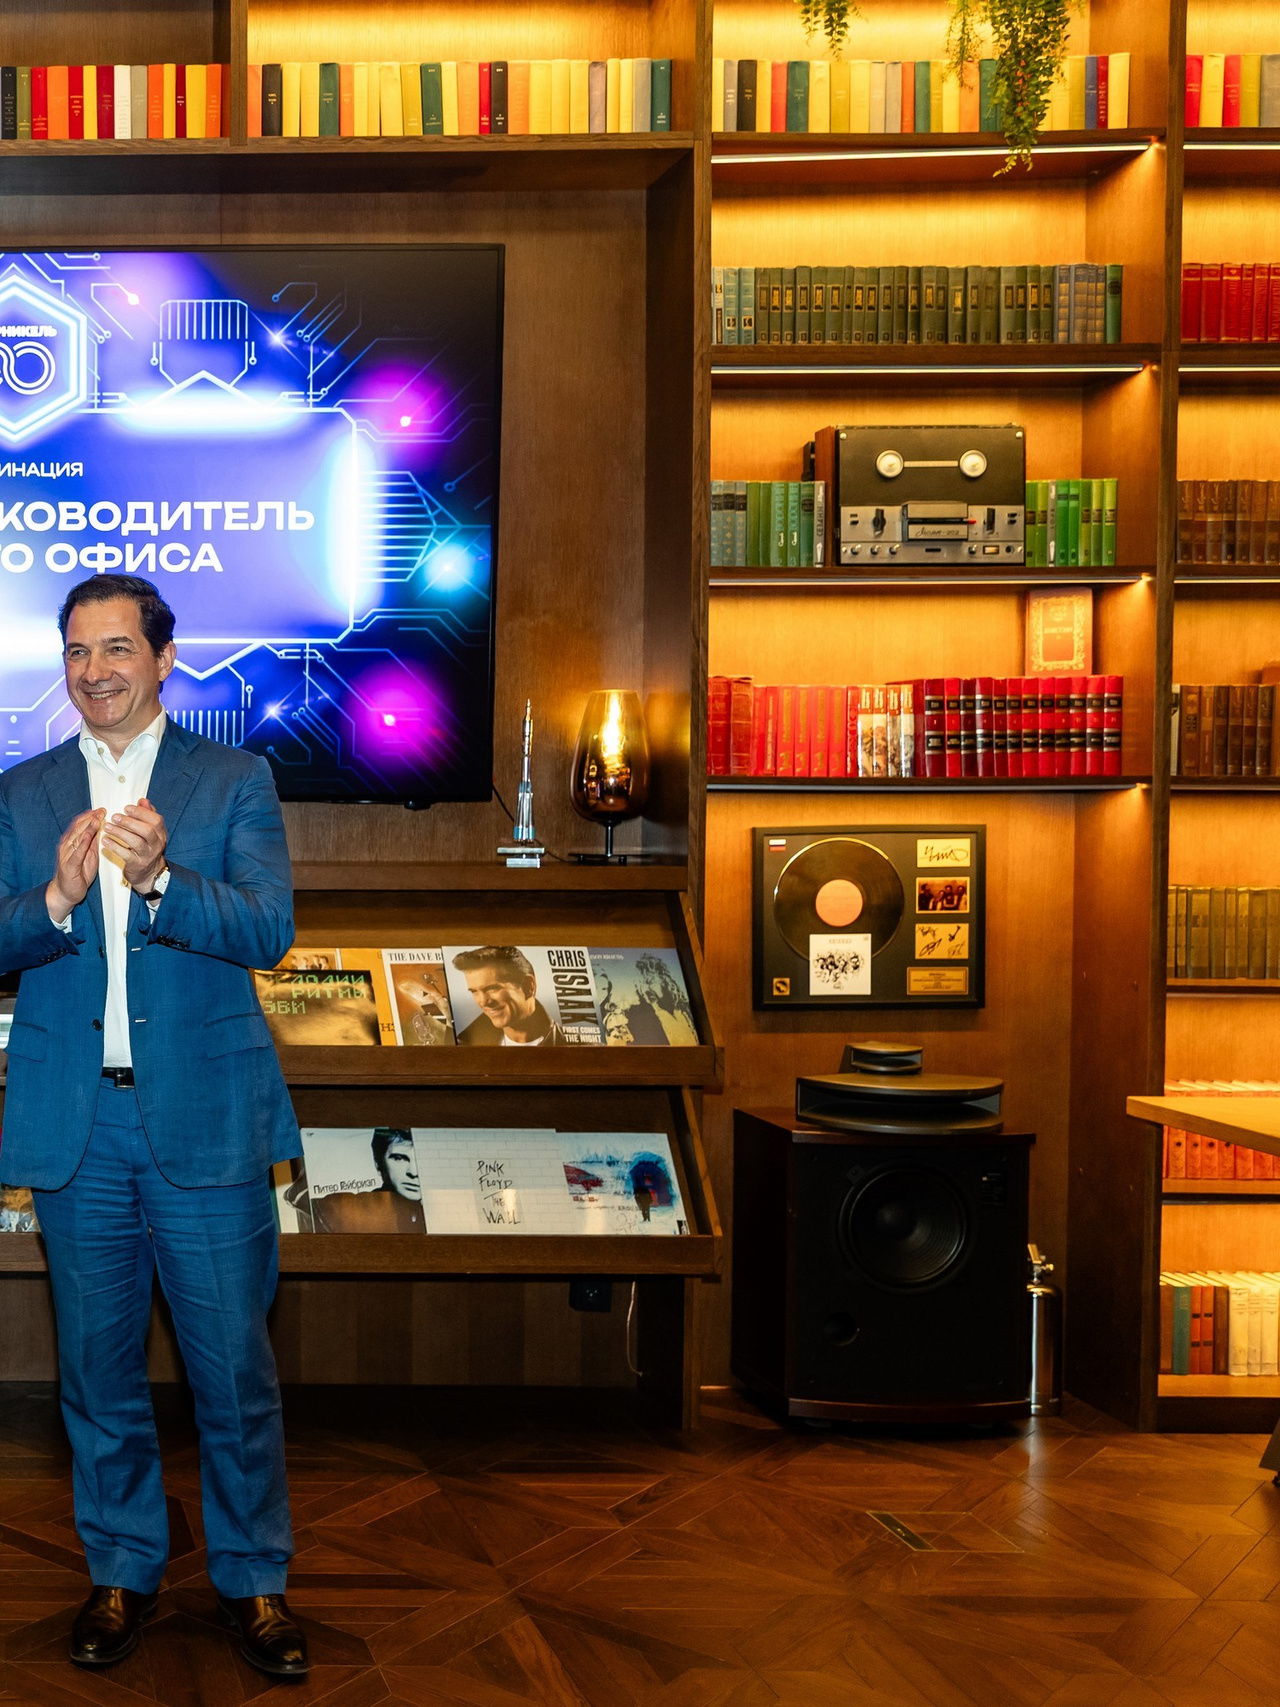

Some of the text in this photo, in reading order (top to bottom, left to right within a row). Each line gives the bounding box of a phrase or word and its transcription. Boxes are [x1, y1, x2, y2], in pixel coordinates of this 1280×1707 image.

[45, 541, 223, 575] ОФИСА
[388, 953, 406, 961] THE
[409, 953, 433, 961] DAVE
[547, 950, 586, 967] CHRIS
[292, 988, 366, 999] РИТМЫ
[551, 968, 599, 1025] ISAAK
[581, 1026, 601, 1034] COMES
[564, 1035, 602, 1043] THE NIGHT
[476, 1160, 504, 1177] PINK
[313, 1178, 376, 1194] Питер Гейбриэл
[478, 1173, 513, 1191] FLOYD
[484, 1191, 506, 1207] THE
